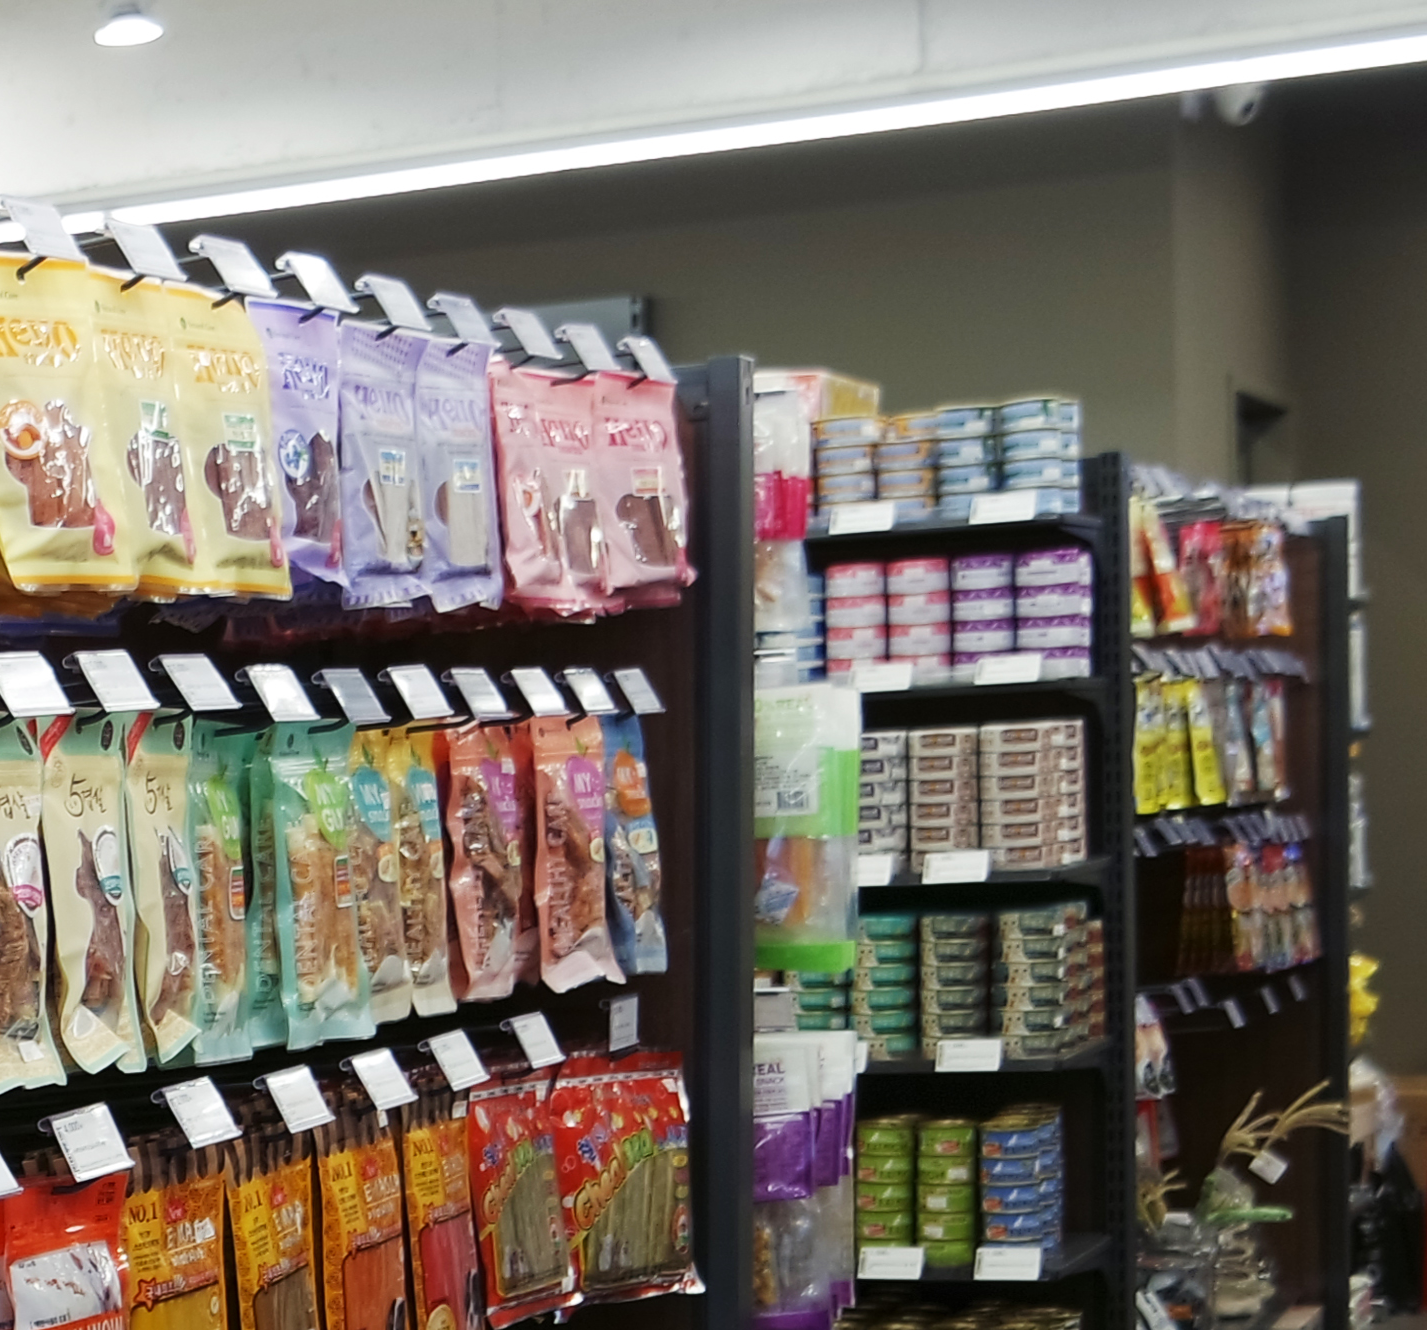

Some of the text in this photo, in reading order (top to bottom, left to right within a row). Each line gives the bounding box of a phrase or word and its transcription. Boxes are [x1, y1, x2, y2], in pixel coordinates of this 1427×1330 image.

[573, 772, 592, 793] MY
[330, 1161, 353, 1184] NO.1
[128, 1201, 158, 1226] NO.1
